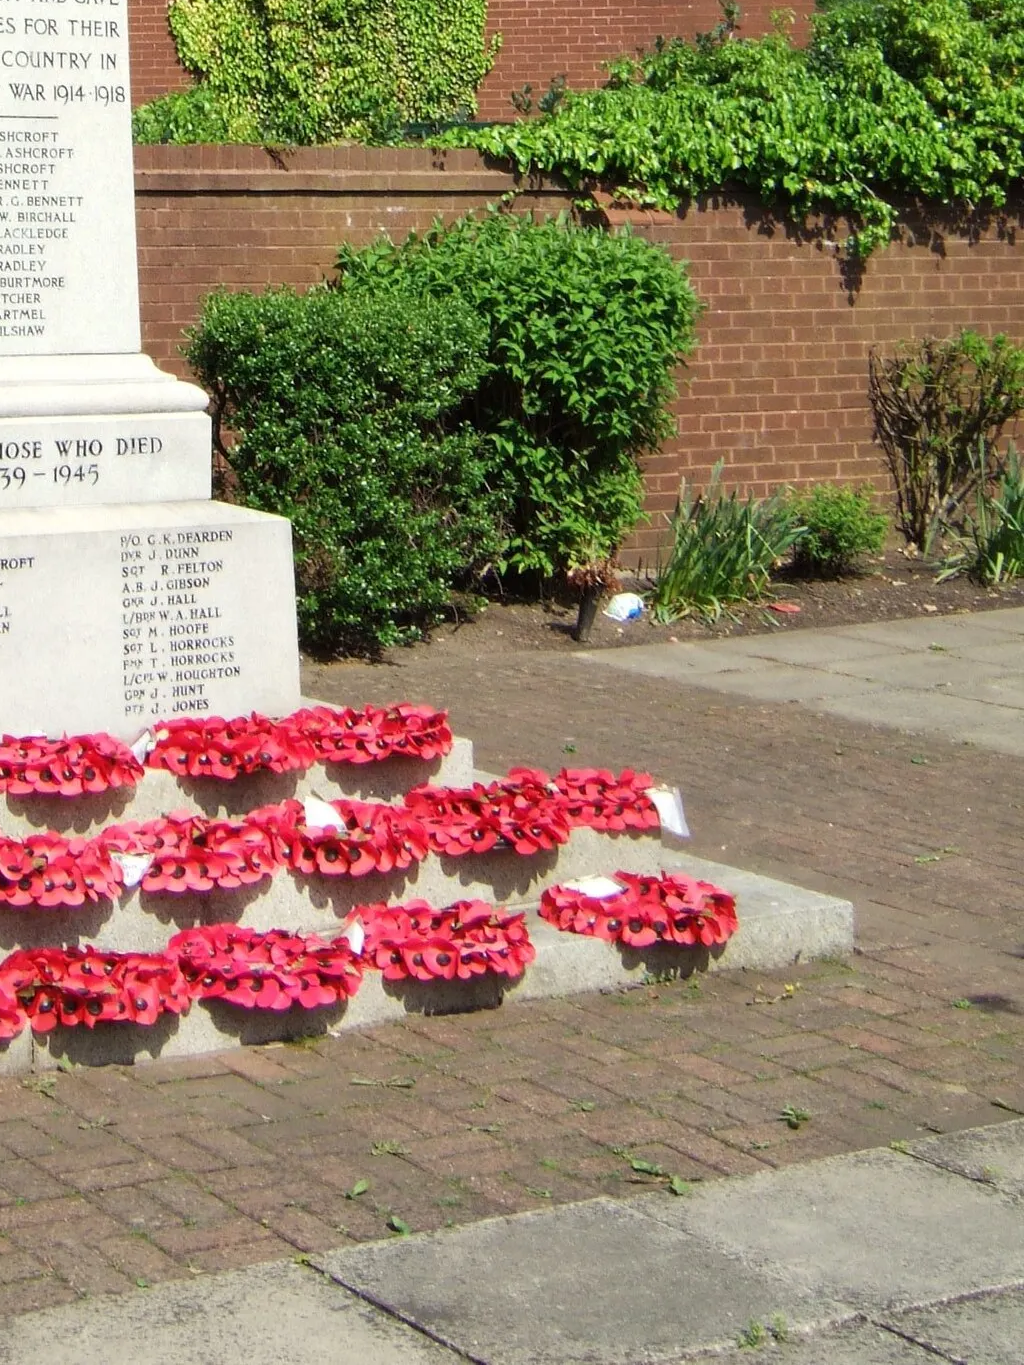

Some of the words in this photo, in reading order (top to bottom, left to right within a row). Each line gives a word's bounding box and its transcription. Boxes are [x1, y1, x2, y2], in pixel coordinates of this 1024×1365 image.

[25, 19, 58, 35] FOR
[68, 20, 120, 37] THEIR
[2, 51, 92, 69] COUNTRY
[100, 54, 116, 70] IN
[9, 84, 45, 101] WAR
[6, 148, 73, 159] ASHCROFT
[27, 196, 83, 206] BENNETT
[18, 212, 75, 222] BIRCHALL
[0, 277, 65, 288] BURTMORE
[55, 439, 102, 458] WHO
[117, 437, 162, 456] DIED
[54, 464, 99, 485] 1945
[178, 530, 233, 544] DEARDEN
[166, 547, 199, 559] DUNN
[178, 561, 223, 574] FELTON
[166, 577, 210, 590] GIBSON
[168, 594, 196, 605] HALL
[191, 607, 222, 619] HALL
[170, 636, 234, 652] HORROCKS
[171, 652, 235, 666] HORROCKS
[176, 666, 241, 681] HOUGHTON
[172, 684, 205, 697] HUNT
[172, 698, 209, 712] JONES
